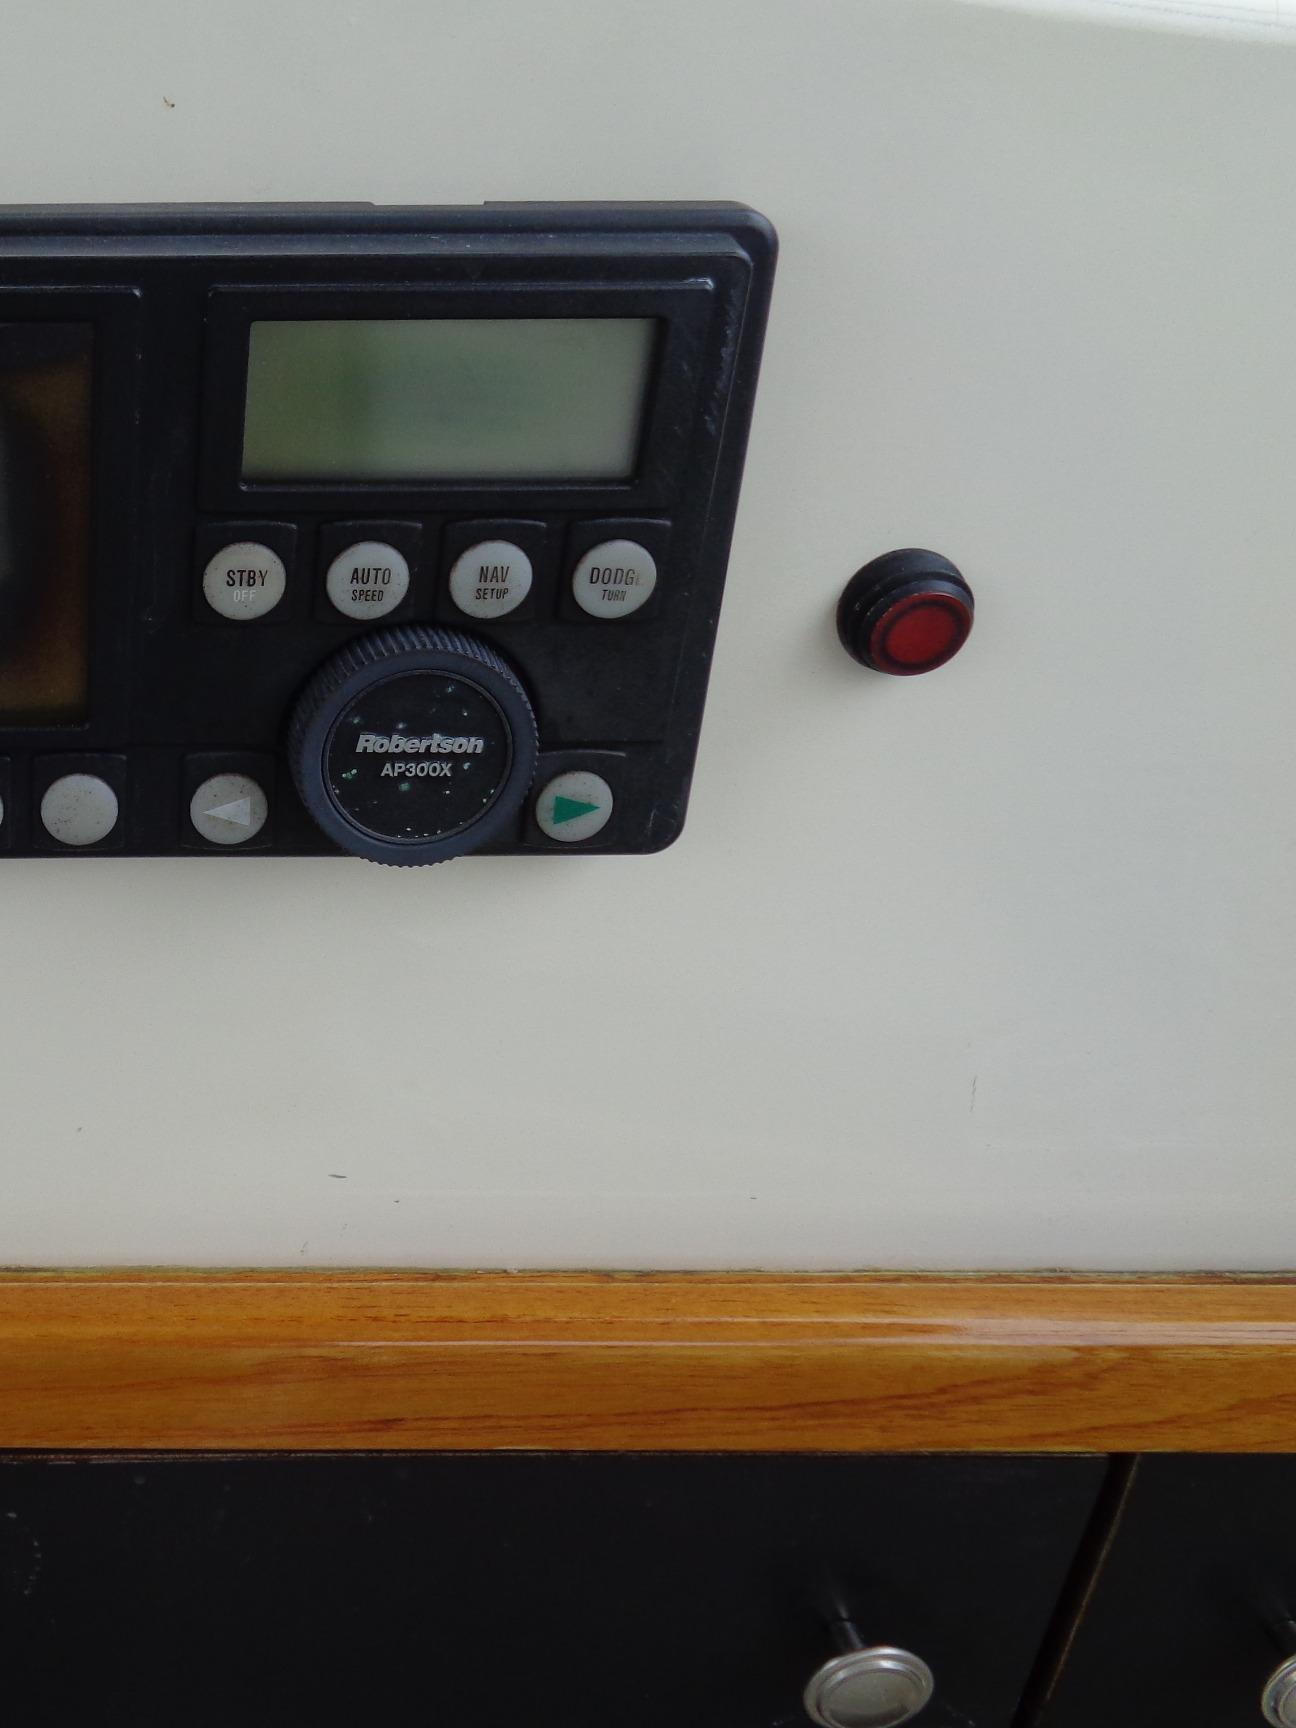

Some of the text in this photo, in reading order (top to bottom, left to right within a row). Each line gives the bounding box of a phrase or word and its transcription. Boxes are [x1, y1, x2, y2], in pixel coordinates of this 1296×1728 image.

[226, 569, 268, 587] STBY
[350, 567, 392, 585] AUTO
[479, 565, 510, 583] NAV
[233, 589, 256, 602] OFF
[351, 589, 384, 602] SPEED
[475, 587, 509, 600] SETUP
[602, 589, 627, 602] TURN
[356, 733, 484, 753] Robertson
[381, 762, 452, 777] AP300X
